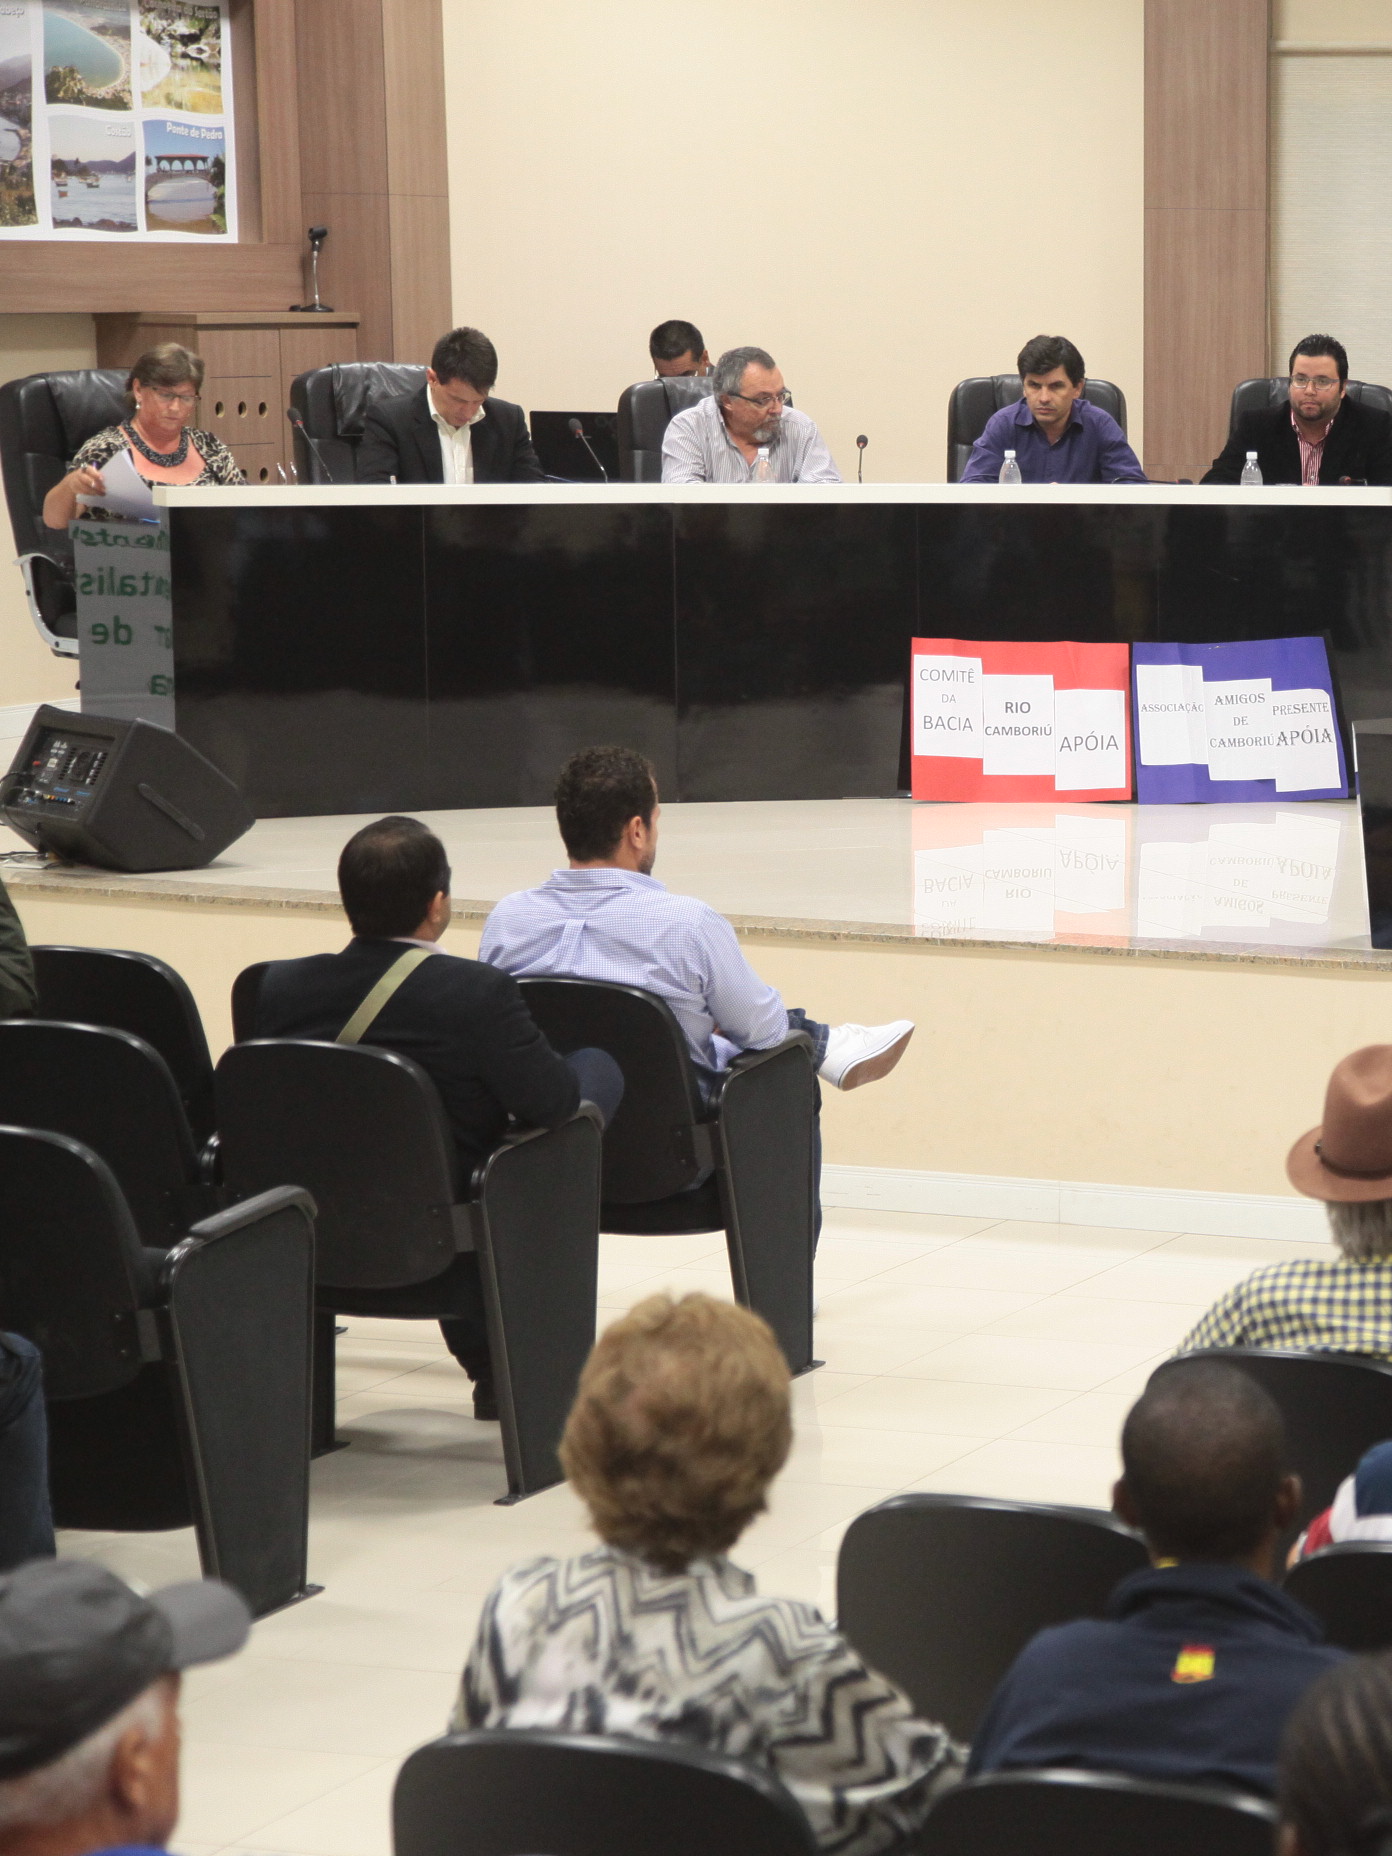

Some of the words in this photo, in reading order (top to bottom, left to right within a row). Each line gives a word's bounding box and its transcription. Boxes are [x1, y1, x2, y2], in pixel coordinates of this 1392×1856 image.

[190, 127, 200, 138] de
[919, 668, 975, 684] COMITÊ
[941, 693, 957, 704] DA
[1214, 692, 1266, 706] AMIGOS
[1004, 701, 1031, 714] RIO
[1272, 702, 1330, 716] PRESENTE
[923, 715, 974, 732] BACIA
[1233, 715, 1249, 727] DE
[984, 724, 1052, 737] CAMBORIÚ
[1276, 725, 1334, 747] APÓIA
[1059, 730, 1119, 753] APÓIA
[1209, 734, 1275, 748] CAMBORIÚ
